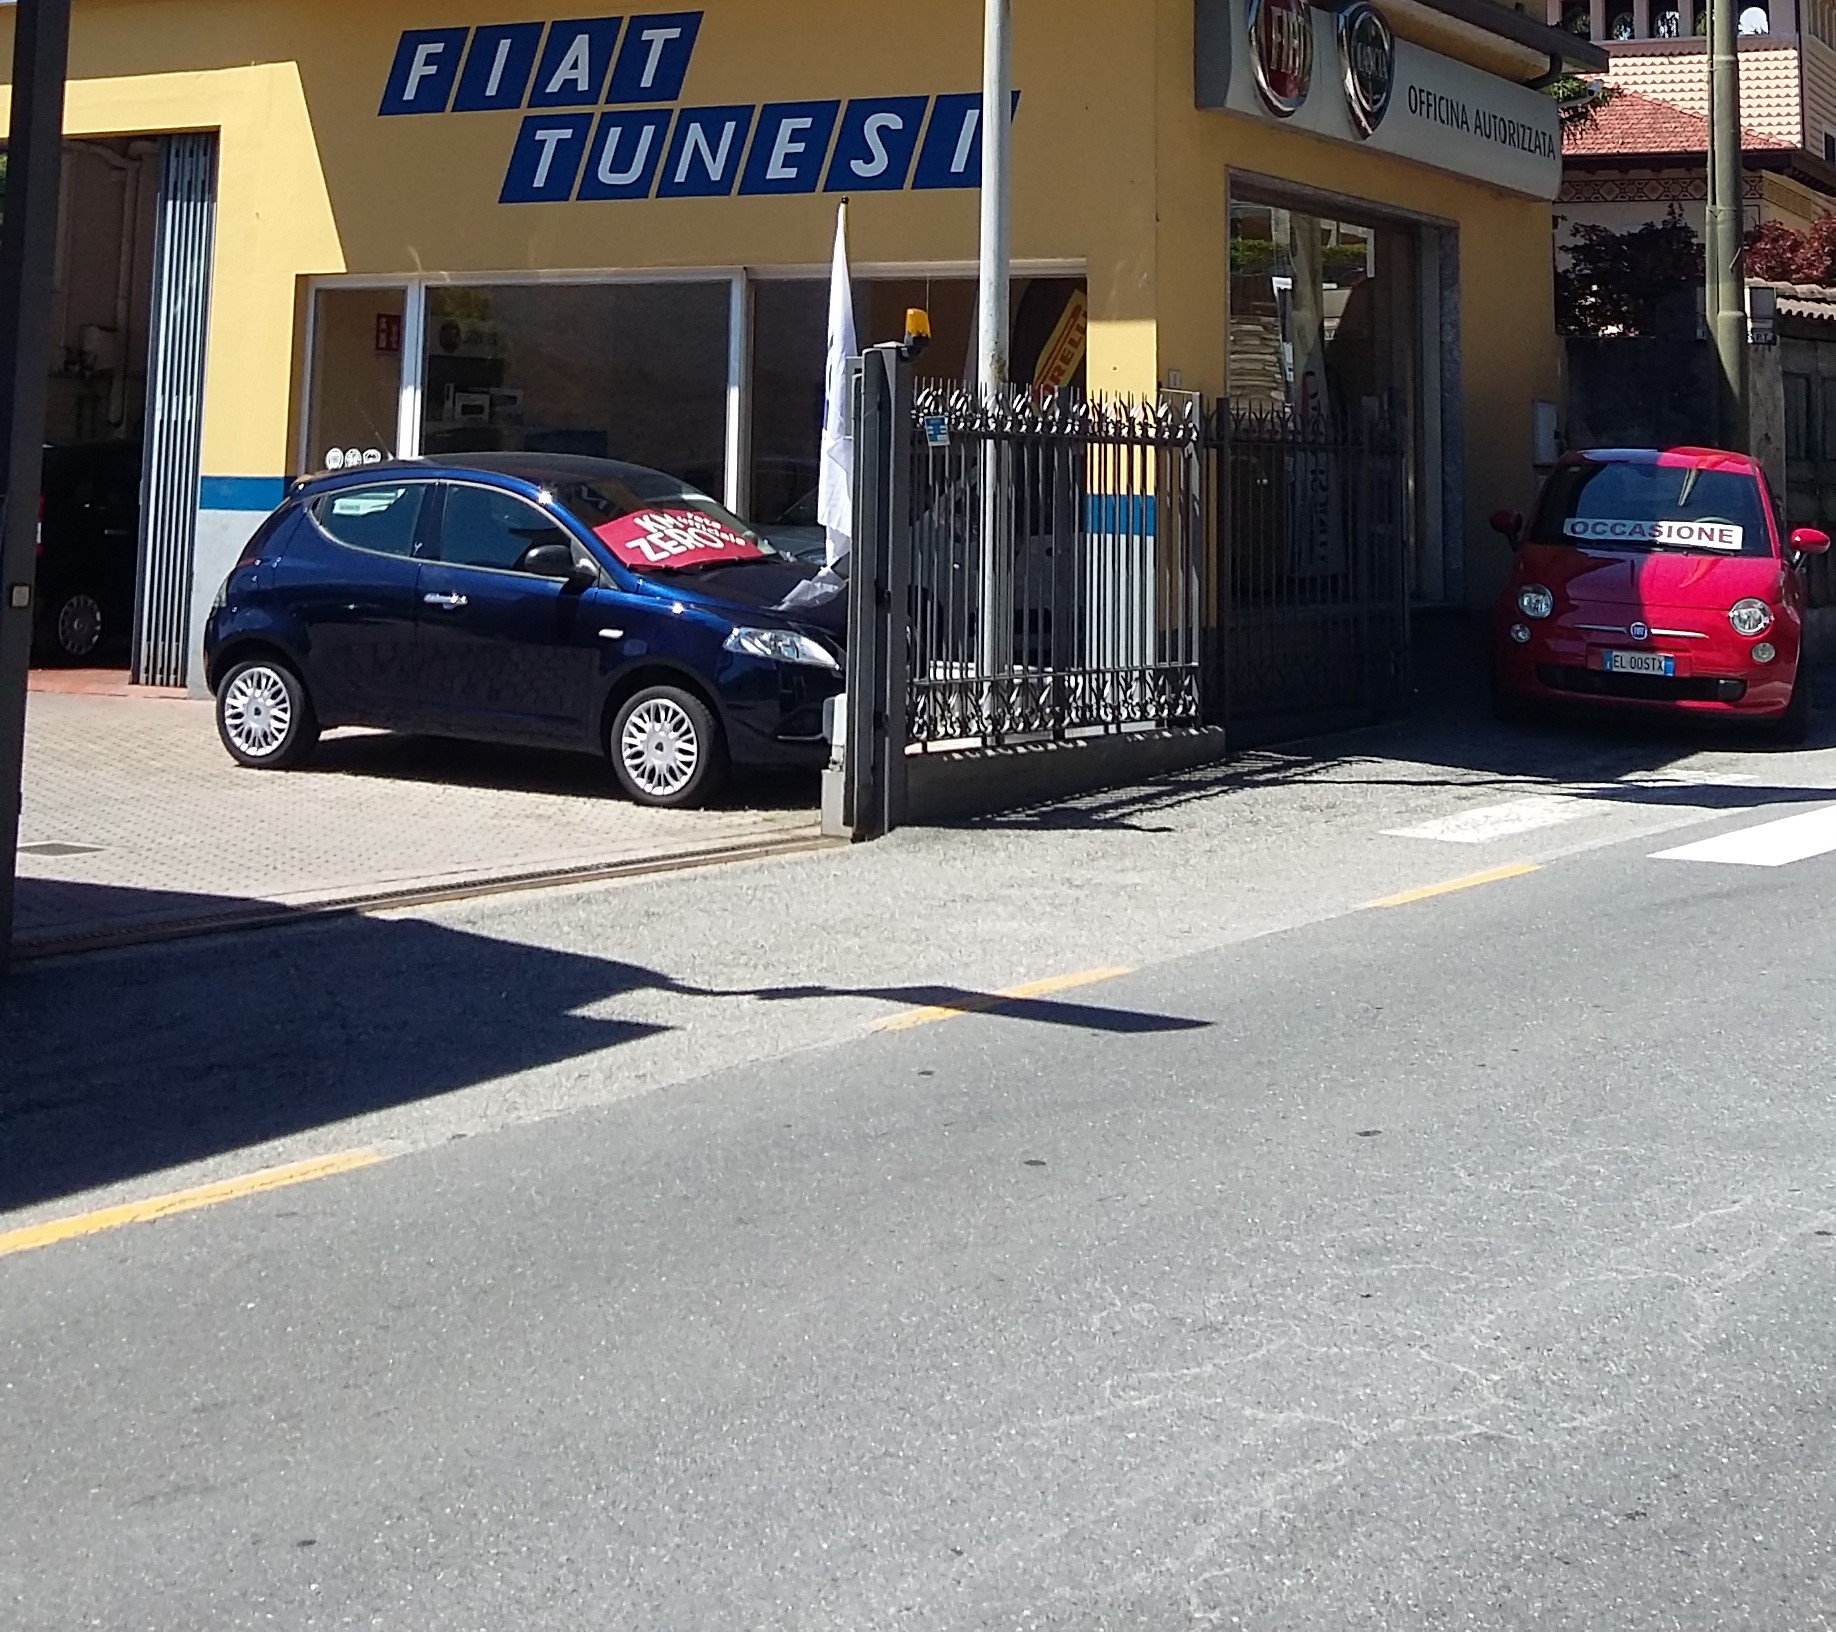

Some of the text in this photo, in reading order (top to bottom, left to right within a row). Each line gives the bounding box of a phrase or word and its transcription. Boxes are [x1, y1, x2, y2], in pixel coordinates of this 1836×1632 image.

[401, 26, 682, 102] FIAT
[1407, 83, 1556, 161] OFFICINA AUTORIZZATA
[531, 109, 981, 188] TUNESI
[633, 512, 683, 534] KM
[1570, 520, 1734, 545] OCCASIONE
[625, 528, 725, 561] ZERO
[1613, 654, 1627, 669] EL
